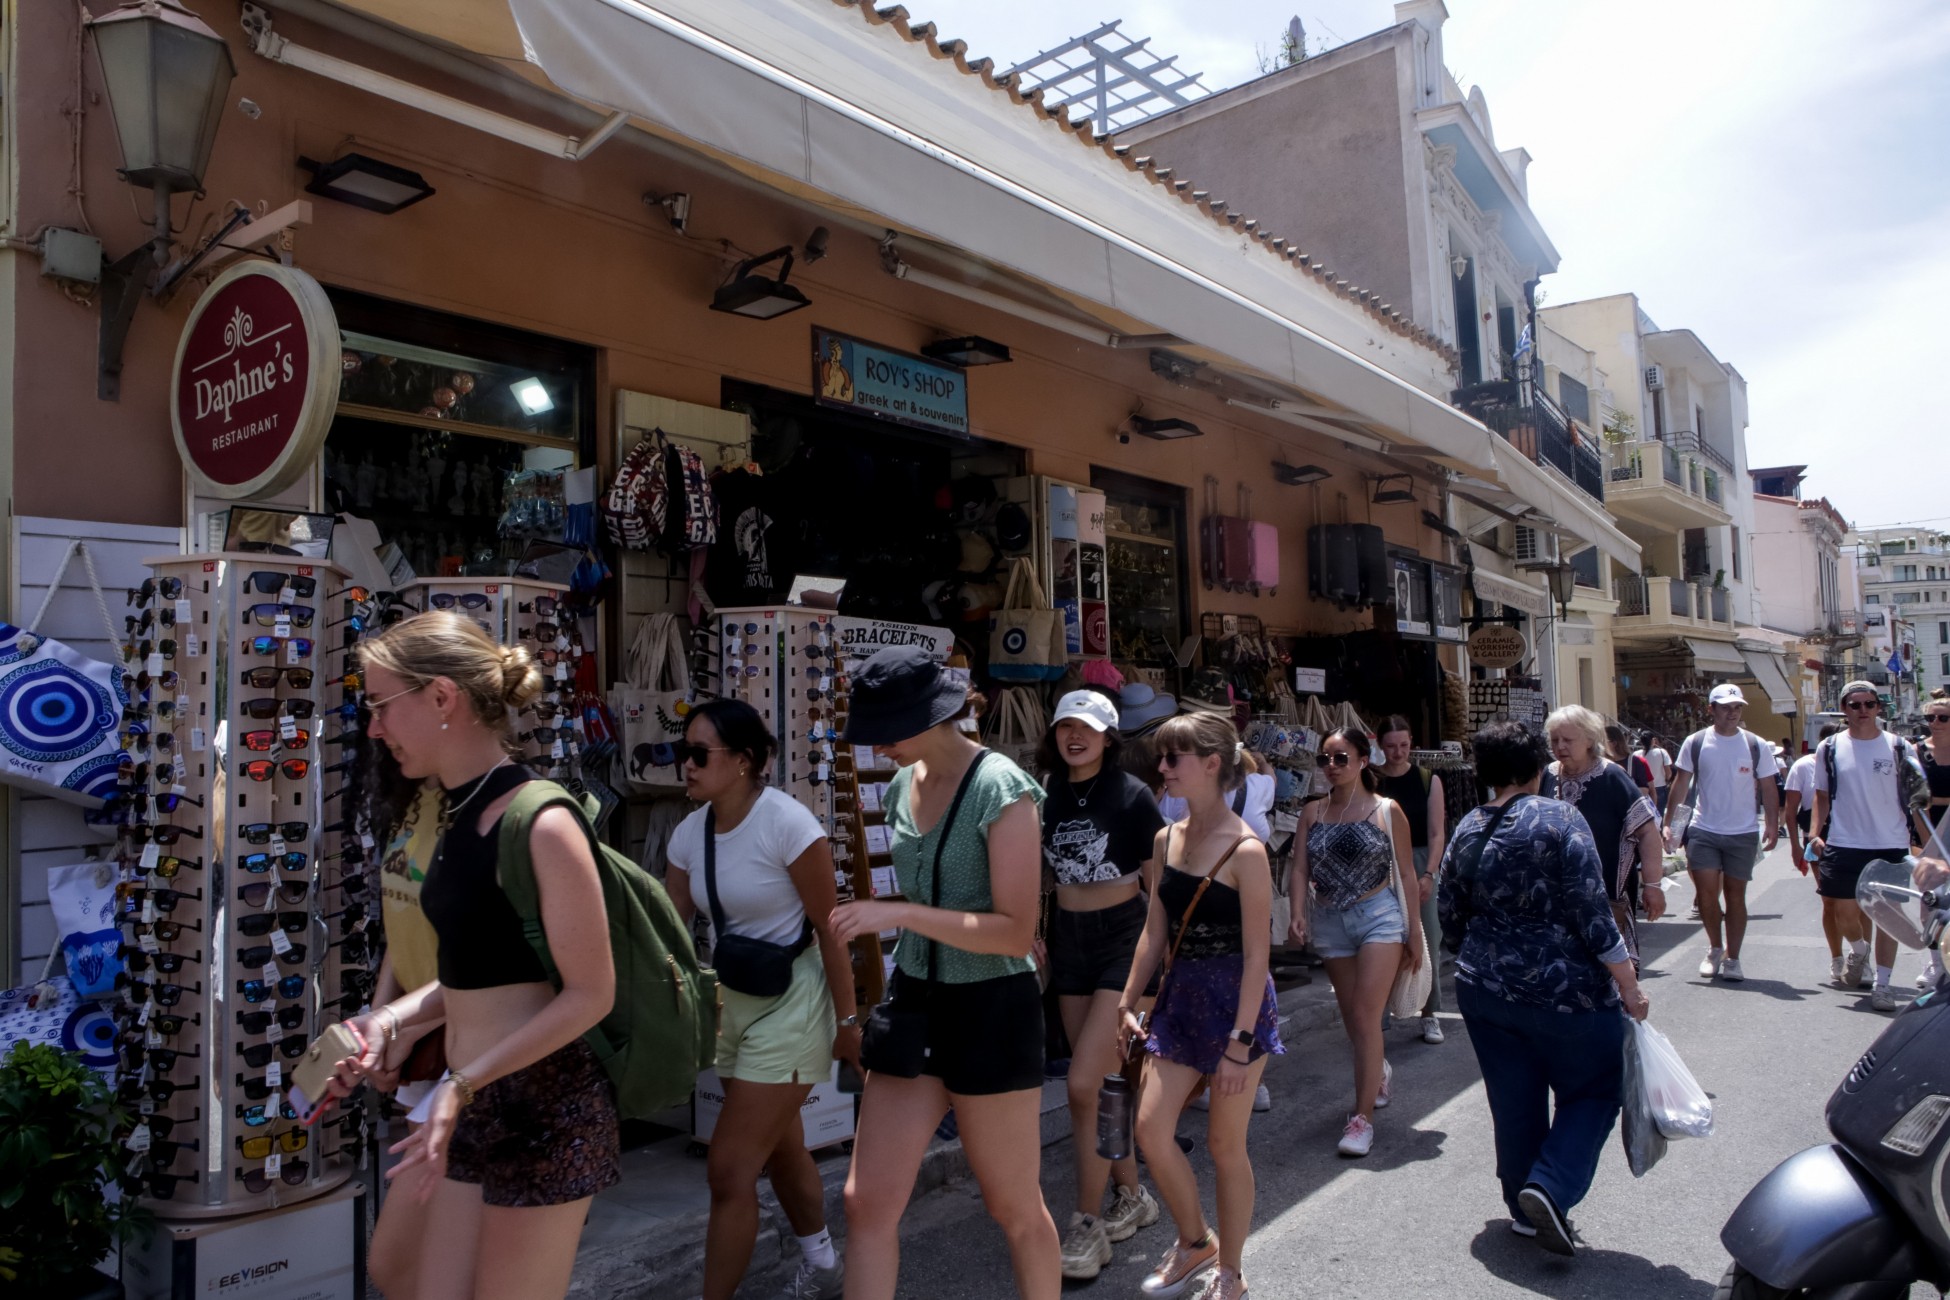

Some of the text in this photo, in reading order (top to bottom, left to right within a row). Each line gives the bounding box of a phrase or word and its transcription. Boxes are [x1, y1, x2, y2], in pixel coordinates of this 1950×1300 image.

[194, 341, 293, 423] Daphne's
[866, 357, 955, 399] ROY'S SHOP
[858, 390, 964, 427] greek art & souvenirs
[212, 414, 279, 451] RESTAURANT
[841, 628, 937, 652] BRACELETS
[872, 621, 918, 631] FASHION
[1472, 643, 1520, 651] WORKSHOP
